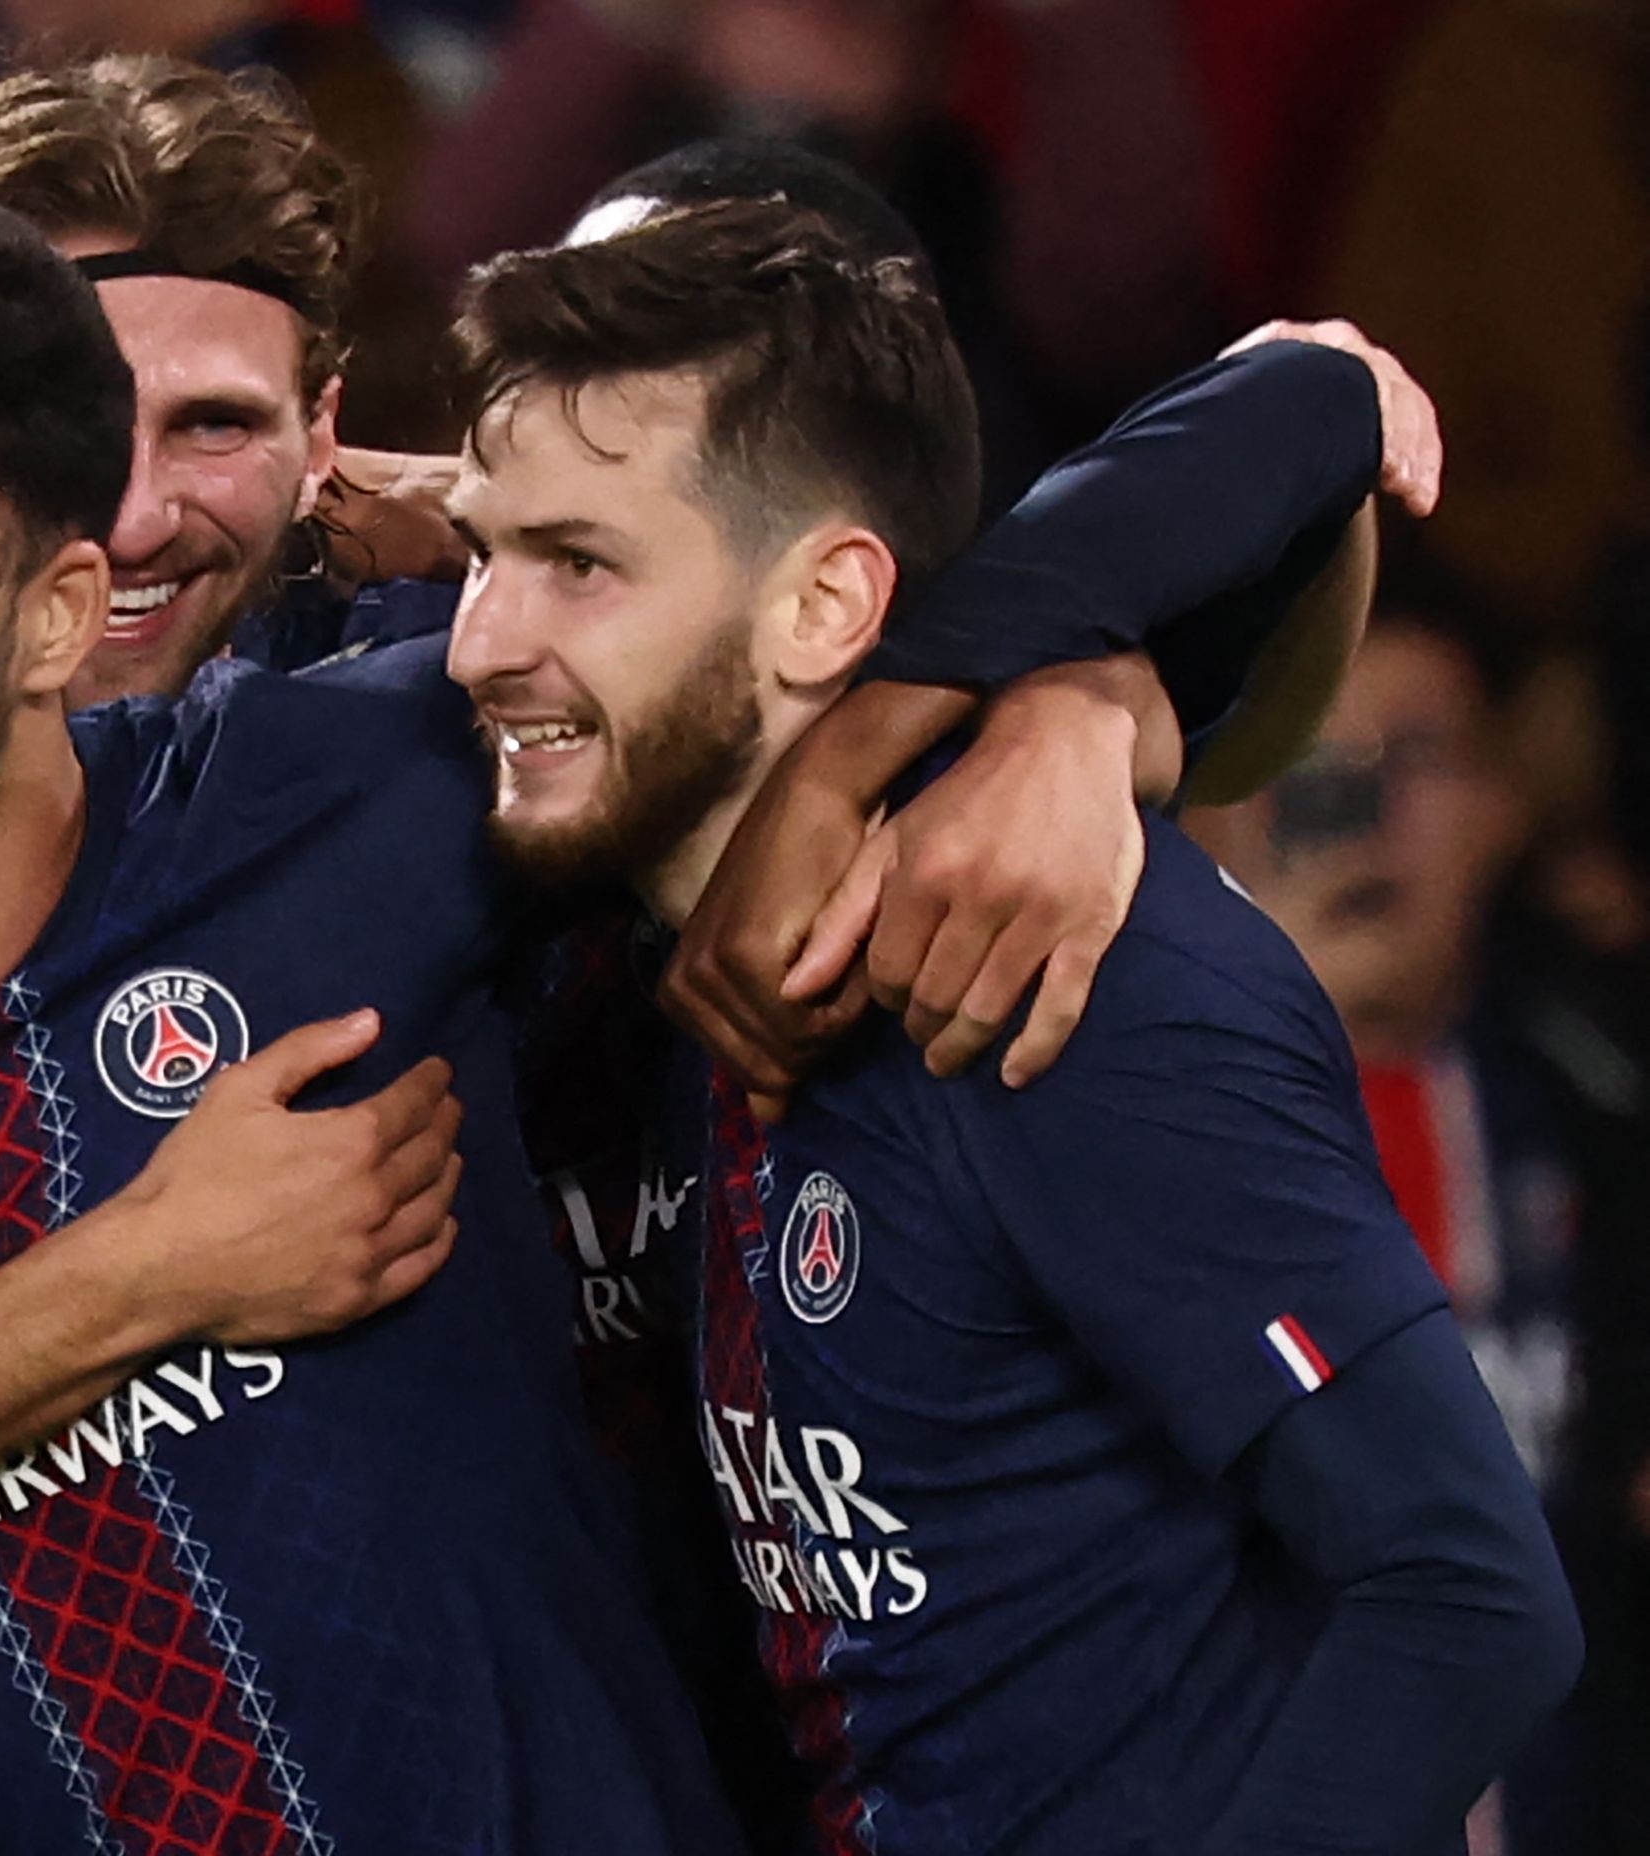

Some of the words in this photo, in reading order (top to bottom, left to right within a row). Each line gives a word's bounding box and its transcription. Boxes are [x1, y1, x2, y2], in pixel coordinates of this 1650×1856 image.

[111, 979, 208, 1026] PARIS
[801, 1178, 846, 1216] PARIS
[702, 1399, 909, 1540] ATAR
[730, 1537, 928, 1622] AIRWAYS
